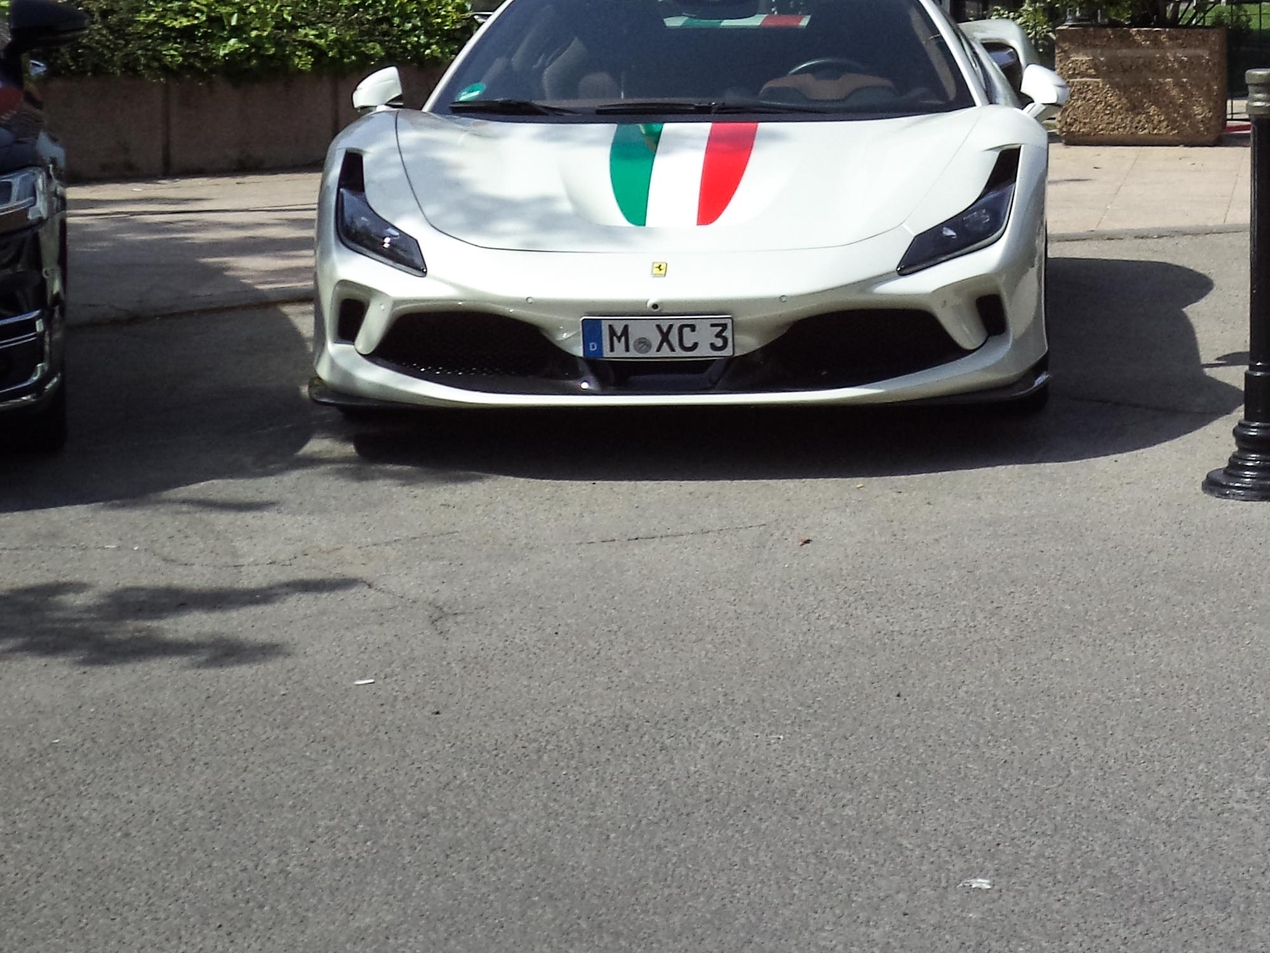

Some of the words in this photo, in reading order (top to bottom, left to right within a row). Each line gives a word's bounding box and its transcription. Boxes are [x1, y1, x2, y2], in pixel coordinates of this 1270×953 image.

[589, 342, 597, 351] D
[607, 324, 630, 353] M
[655, 323, 699, 353] XC
[709, 323, 729, 352] 3
